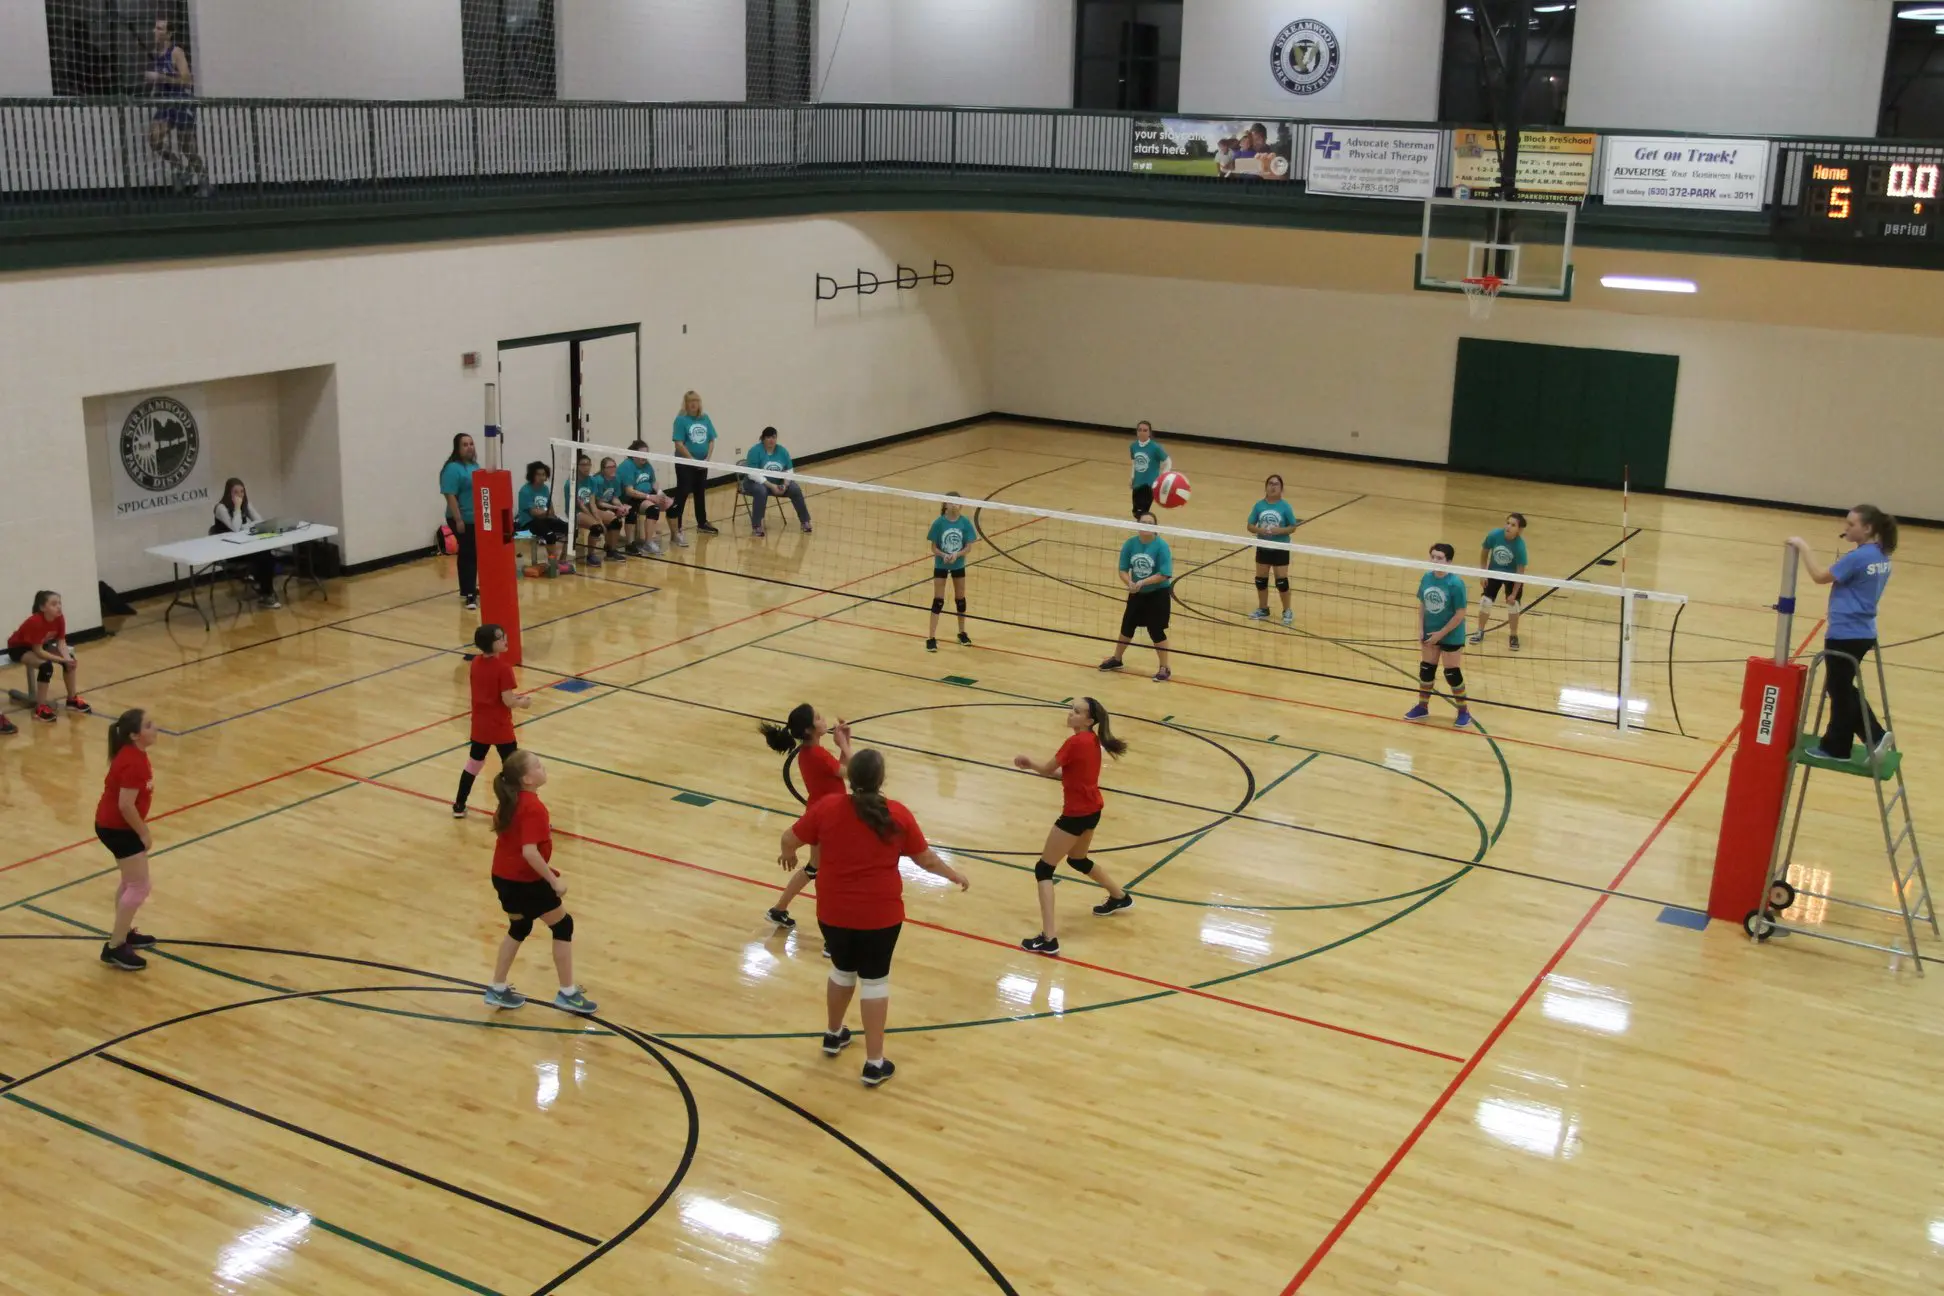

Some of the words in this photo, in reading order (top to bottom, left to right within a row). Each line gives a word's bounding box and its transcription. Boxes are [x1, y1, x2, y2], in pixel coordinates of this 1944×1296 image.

[1276, 22, 1335, 50] STREAMWOOD
[1273, 60, 1289, 84] PARK
[1294, 61, 1336, 93] DISTRICT
[1134, 130, 1157, 142] your
[1346, 137, 1389, 149] Advocate
[1393, 139, 1435, 151] Sherman
[1524, 135, 1547, 144] Block
[1549, 136, 1592, 145] PreSchool
[1134, 143, 1159, 154] starts
[1162, 143, 1189, 155] here.
[1348, 150, 1387, 160] Physical
[1391, 151, 1428, 164] Therapy
[1634, 147, 1658, 161] Get
[1663, 151, 1682, 161] on
[1688, 148, 1738, 165] Track!
[1613, 167, 1667, 177] ADVERTISE
[1670, 169, 1688, 178] Your
[1692, 170, 1731, 180] Business
[1734, 172, 1756, 181] Here
[1812, 163, 1849, 181] Home
[1626, 188, 1646, 197] today
[1669, 187, 1717, 198] 372-PARK
[1734, 191, 1754, 200] 3011
[1828, 185, 1853, 219] 5
[1913, 202, 1923, 215] 3
[1884, 222, 1928, 237] period
[125, 400, 193, 436] STREAMWOOD
[124, 452, 145, 483] PARK
[153, 447, 196, 487] DISTRICT
[117, 487, 208, 515] SPDCARES.COM
[482, 488, 491, 524] PORTER
[1759, 687, 1778, 736] PORTER
